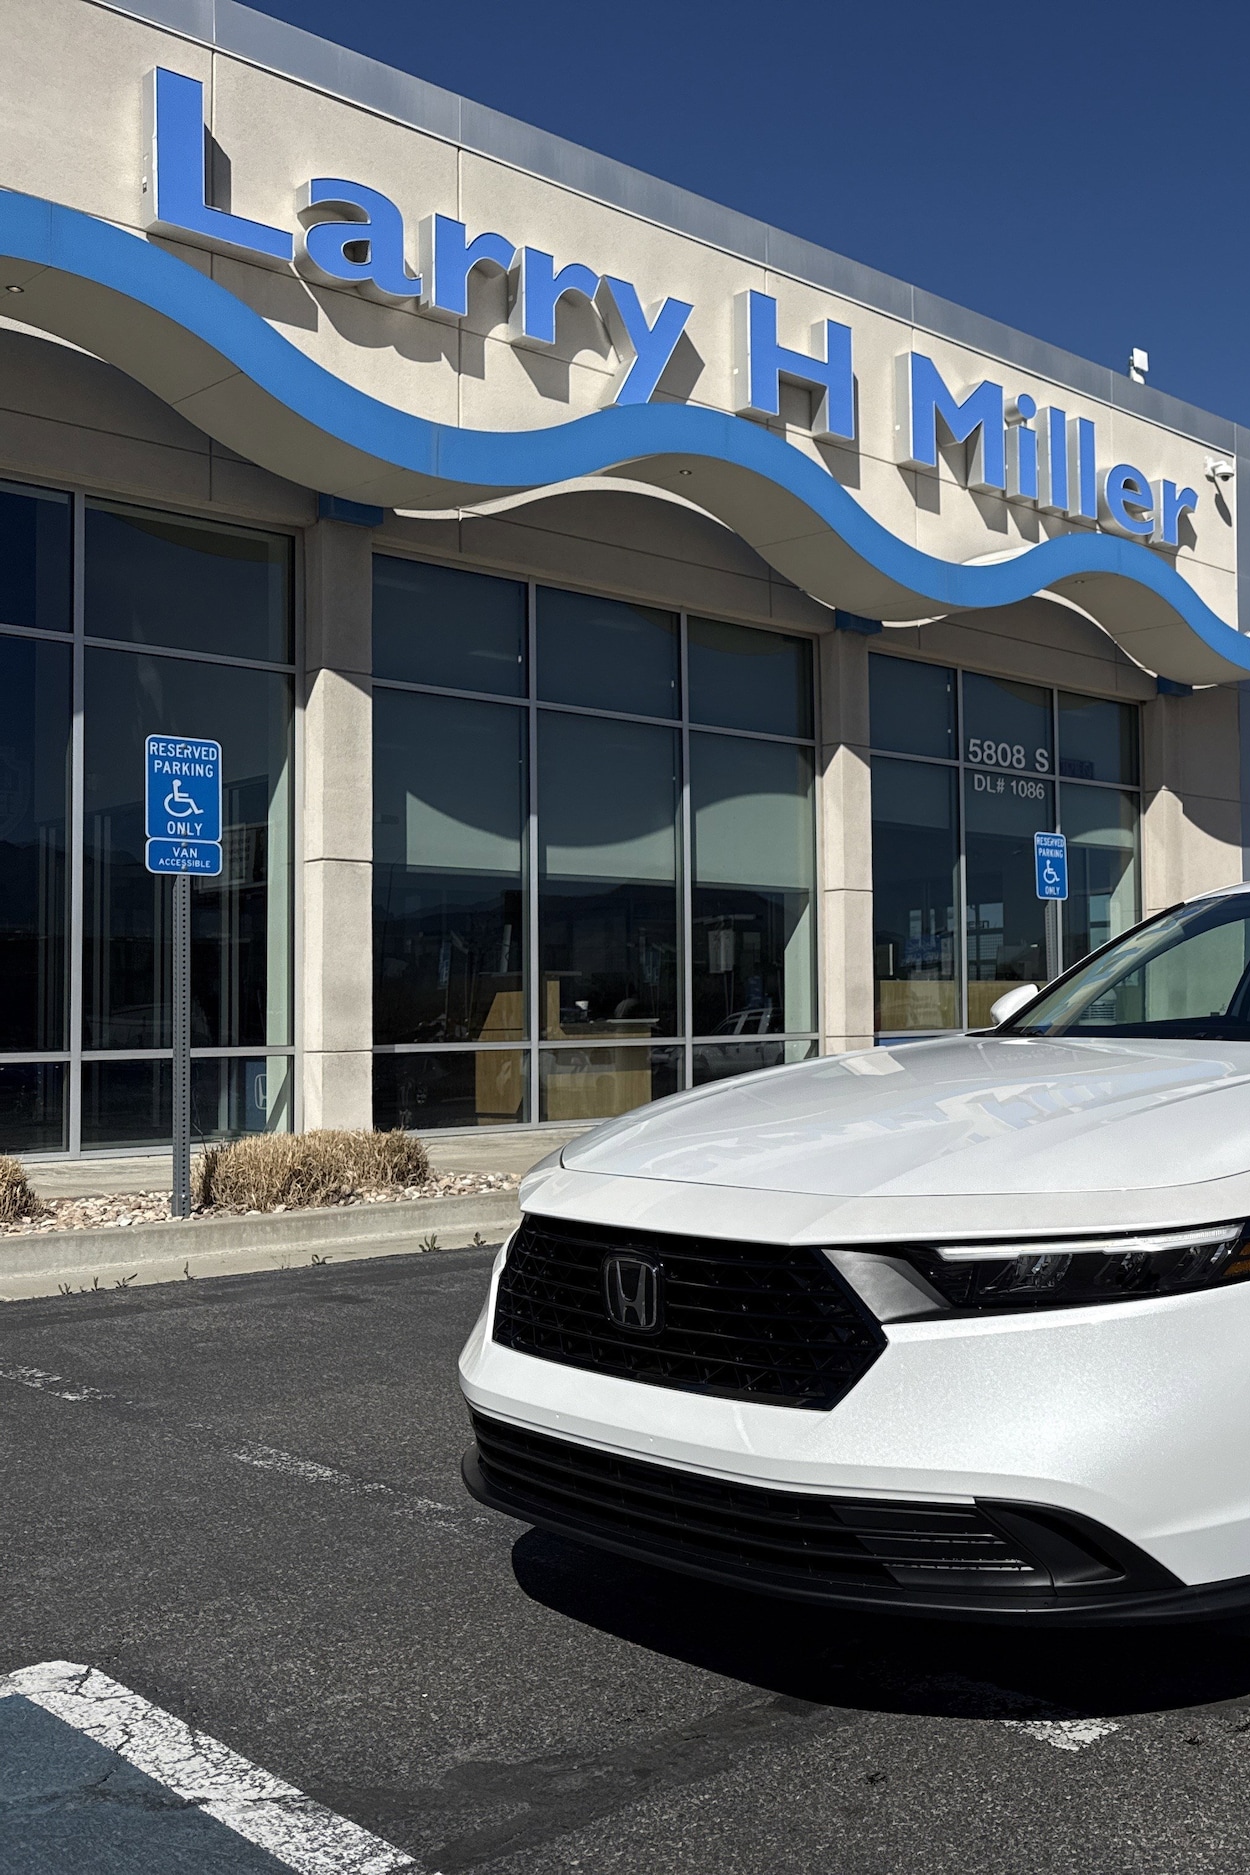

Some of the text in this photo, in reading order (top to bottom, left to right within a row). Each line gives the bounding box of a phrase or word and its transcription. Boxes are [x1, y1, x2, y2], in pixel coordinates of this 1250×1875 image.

[146, 66, 1199, 547] Larry H Miller
[150, 741, 217, 761] RESERVED
[968, 738, 1026, 769] 5808
[1035, 748, 1050, 773] S
[154, 760, 214, 778] PARKING
[973, 774, 1045, 800] DL# 1086
[167, 820, 203, 836] ONLY
[1036, 836, 1064, 848] RESERVED
[173, 847, 198, 859] VAN
[1038, 847, 1064, 859] PARKING
[158, 858, 211, 868] ACCESSIBLE
[1044, 886, 1061, 896] ONLY
